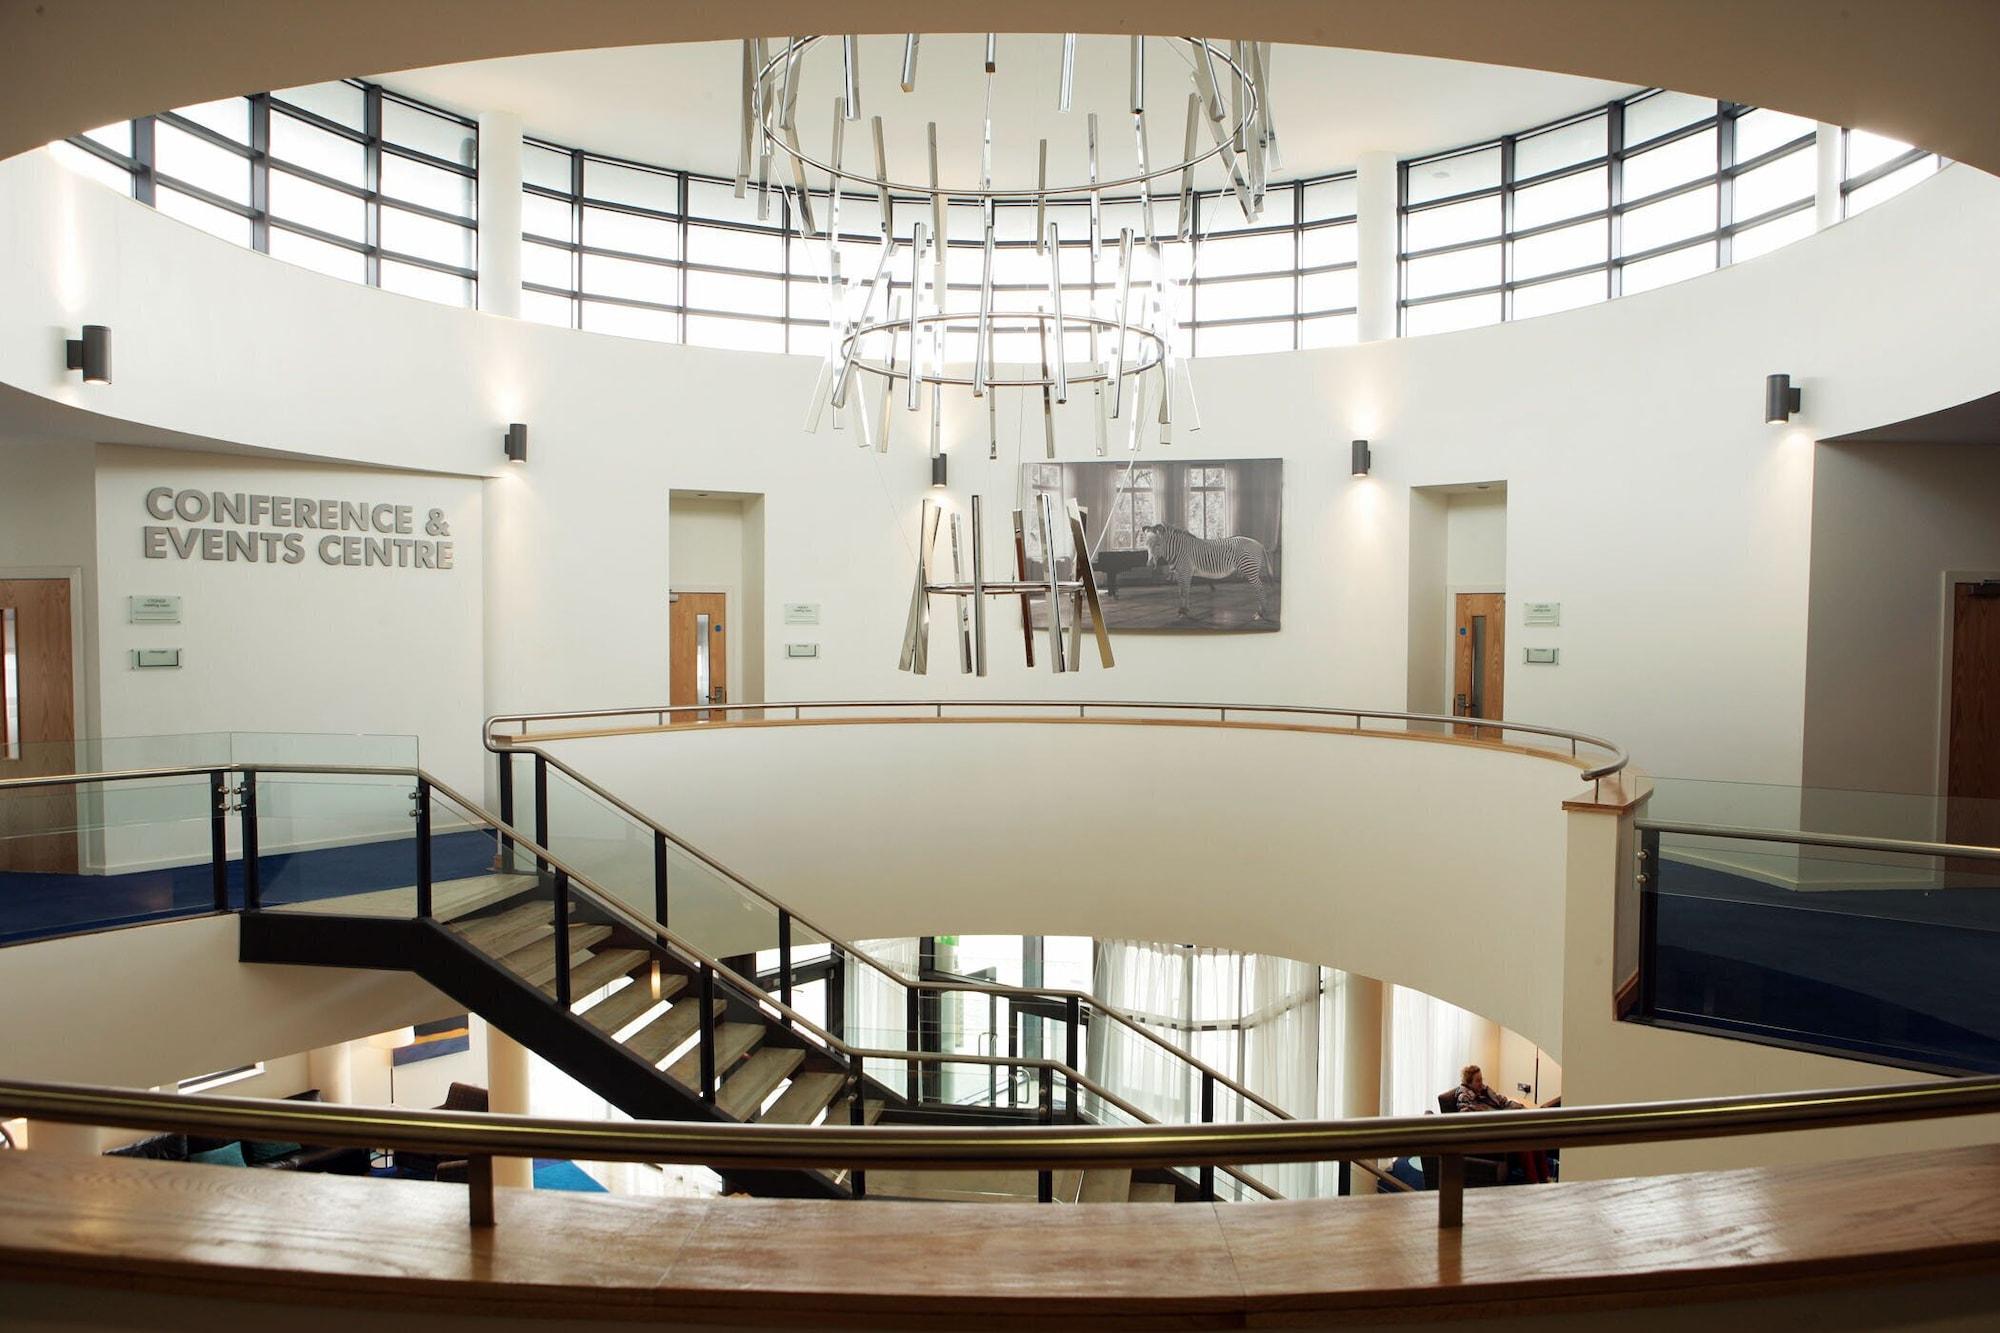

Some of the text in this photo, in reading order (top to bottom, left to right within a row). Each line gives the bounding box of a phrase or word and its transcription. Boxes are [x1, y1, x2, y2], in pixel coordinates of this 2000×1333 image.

[146, 486, 451, 537] CONFERENCE &
[144, 525, 454, 570] EVENTS CENTRE
